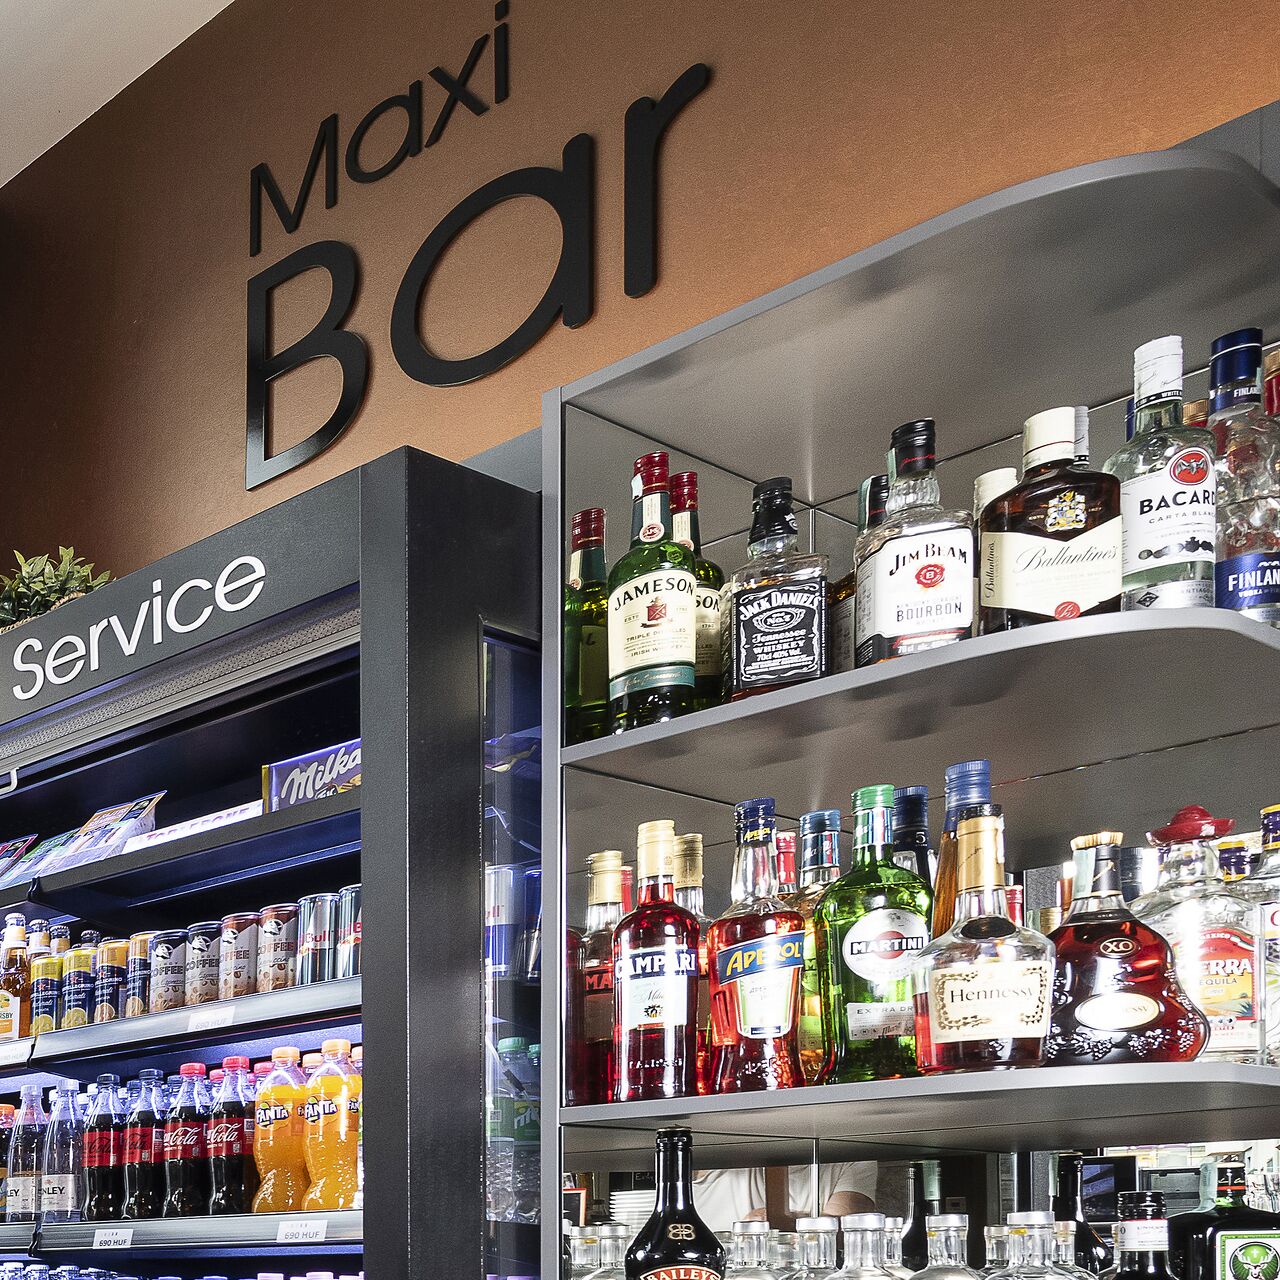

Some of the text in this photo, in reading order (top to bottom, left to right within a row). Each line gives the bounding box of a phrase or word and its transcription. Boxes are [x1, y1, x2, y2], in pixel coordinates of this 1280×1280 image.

[249, 1, 510, 256] Maxi
[246, 62, 709, 490] Bar
[1234, 386, 1259, 397] FINLA
[1139, 490, 1216, 516] BACARD
[1148, 512, 1188, 524] CARTA
[889, 543, 968, 576] JIM BEAM
[1014, 545, 1118, 573] Ballantine's
[984, 541, 996, 599] Ballantine's
[614, 578, 694, 611] JAMESON
[739, 594, 773, 621] JACK
[772, 591, 822, 608] DANIEL'S
[896, 602, 962, 623] BOURBON
[13, 554, 266, 702] Service
[626, 632, 651, 643] TRIPLE
[752, 629, 807, 644] Tennessee
[630, 648, 651, 657] IRISH
[752, 640, 805, 655] WHISKEY
[772, 651, 788, 660] 40%
[280, 742, 361, 804] Milka
[744, 827, 772, 841] APEROL
[916, 831, 926, 843] 5
[852, 937, 923, 955] MARTINI
[1105, 941, 1133, 953] XO
[1199, 977, 1238, 986] EQUILA
[950, 989, 1033, 1004] Hennessy
[856, 1006, 896, 1015] EXRA
[256, 1106, 289, 1126] FANTA
[304, 1098, 337, 1123] FANTA
[99, 1238, 128, 1247] 690 HUF
[284, 1230, 321, 1240] 690 HUF
